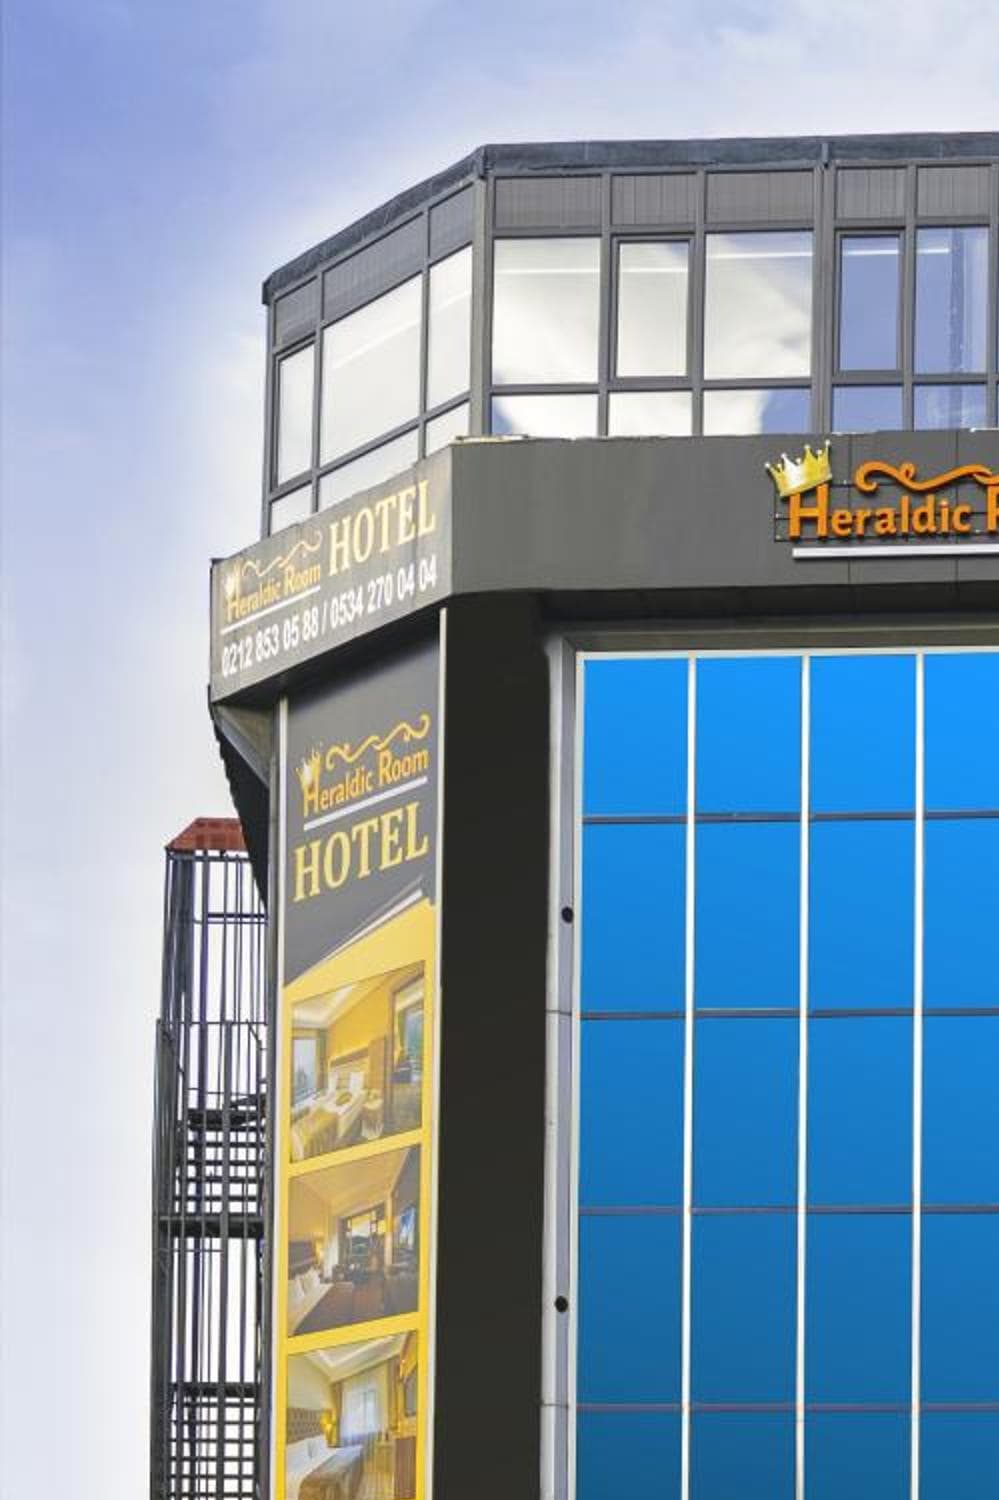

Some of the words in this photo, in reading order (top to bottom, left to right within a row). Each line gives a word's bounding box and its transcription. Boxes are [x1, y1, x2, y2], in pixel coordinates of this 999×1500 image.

[226, 567, 282, 622] Heraldic
[284, 564, 321, 598] Room
[328, 479, 437, 577] HOTEL
[789, 484, 972, 538] Heraldic
[221, 636, 254, 678] 0212
[255, 624, 280, 660] 853
[283, 615, 301, 651] 05
[302, 605, 320, 642] 88
[330, 585, 364, 629] 0534
[367, 572, 393, 614] 270
[397, 562, 416, 599] 04
[419, 553, 438, 592] 04
[303, 760, 374, 818] Heraldic
[377, 749, 429, 786] Room
[293, 801, 430, 903] HOTEL
